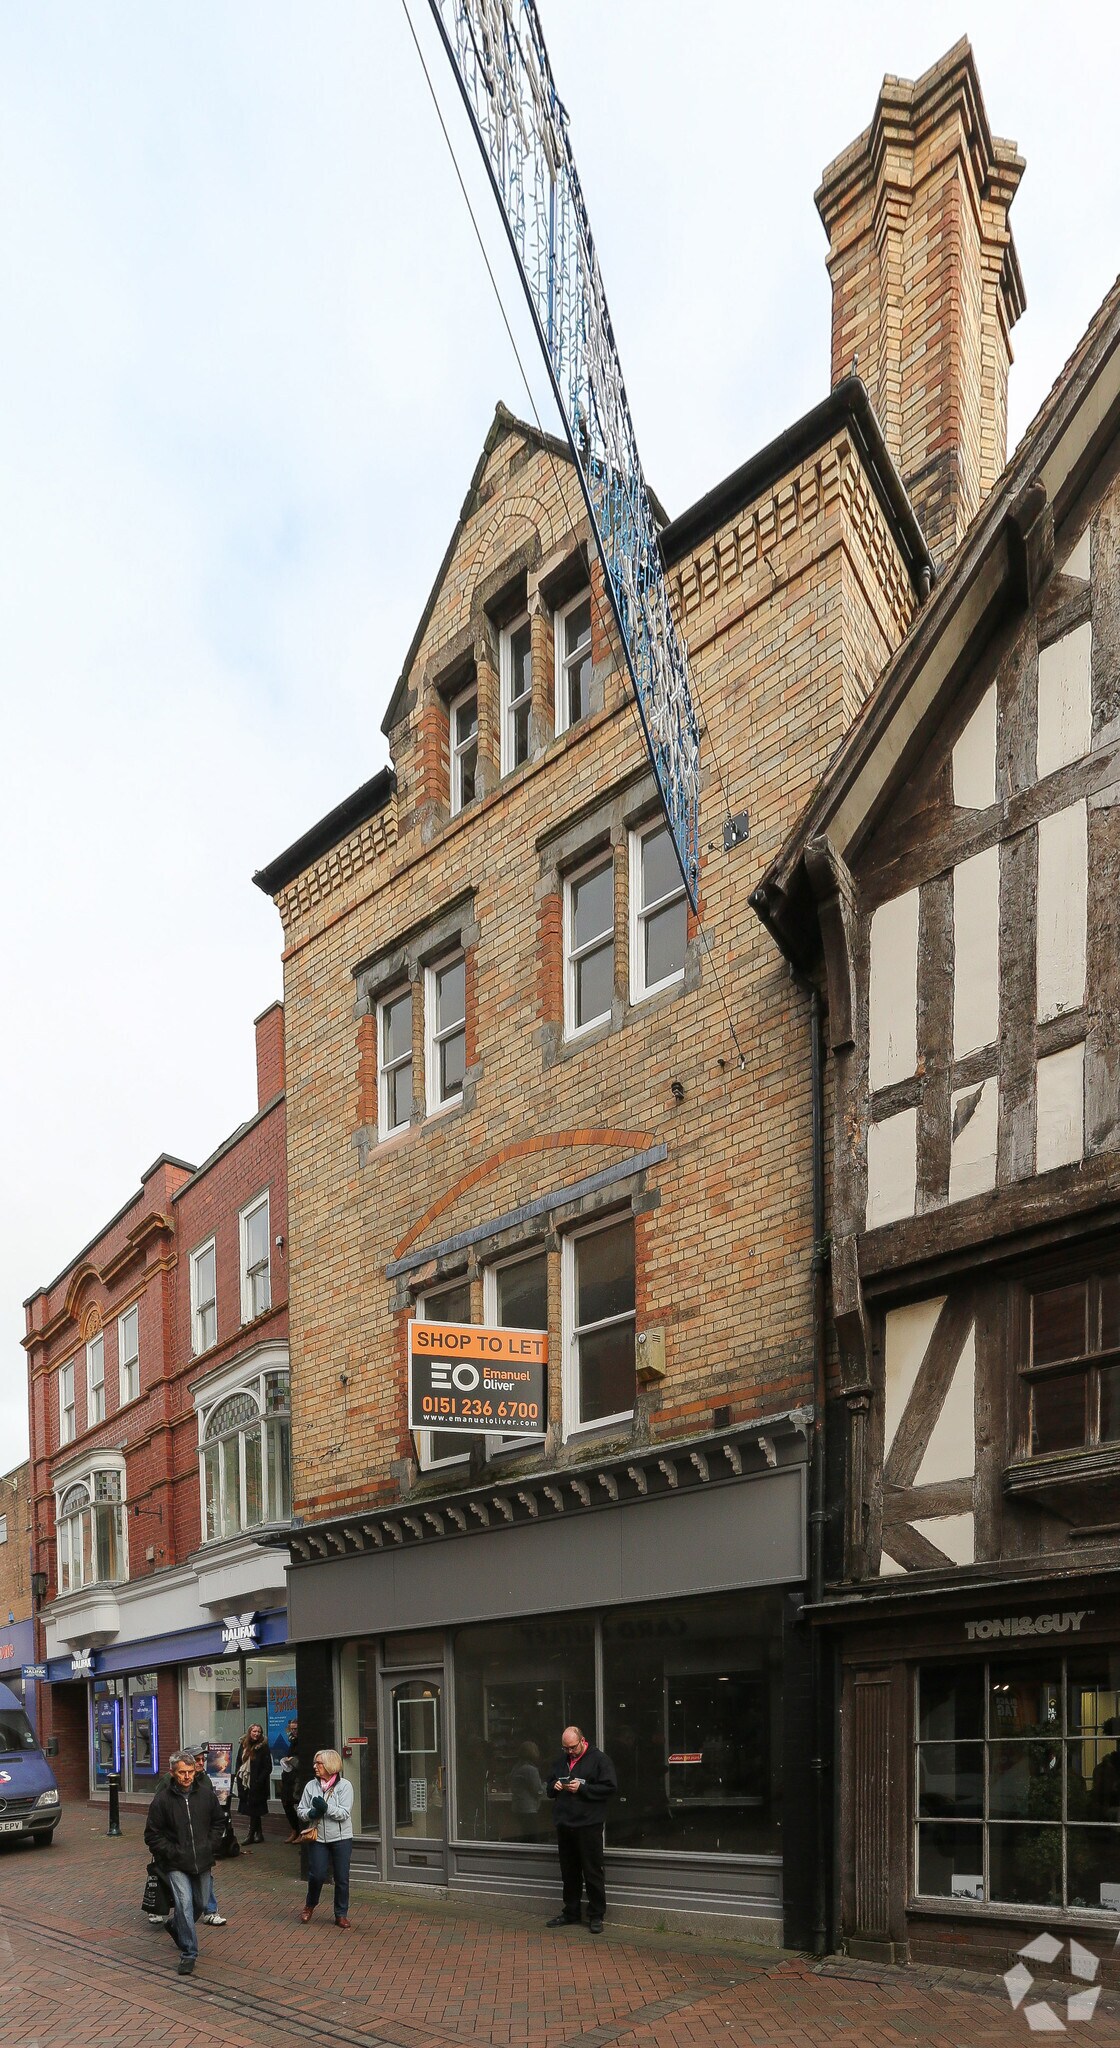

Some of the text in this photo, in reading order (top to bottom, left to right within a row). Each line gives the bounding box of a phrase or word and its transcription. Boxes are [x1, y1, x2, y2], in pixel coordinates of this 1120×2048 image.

[417, 1331, 544, 1356] SHOP TO LET
[483, 1367, 531, 1381] Emanuel
[483, 1379, 515, 1391] Oliver
[422, 1396, 539, 1419] 0151 236 6700
[423, 1414, 538, 1427] www.emanueloliver.com
[964, 1610, 1087, 1640] TONI&GUY
[222, 1624, 256, 1642] HALIFAX
[71, 1656, 92, 1671] HALIFAX
[4, 1822, 20, 1831] EPV
